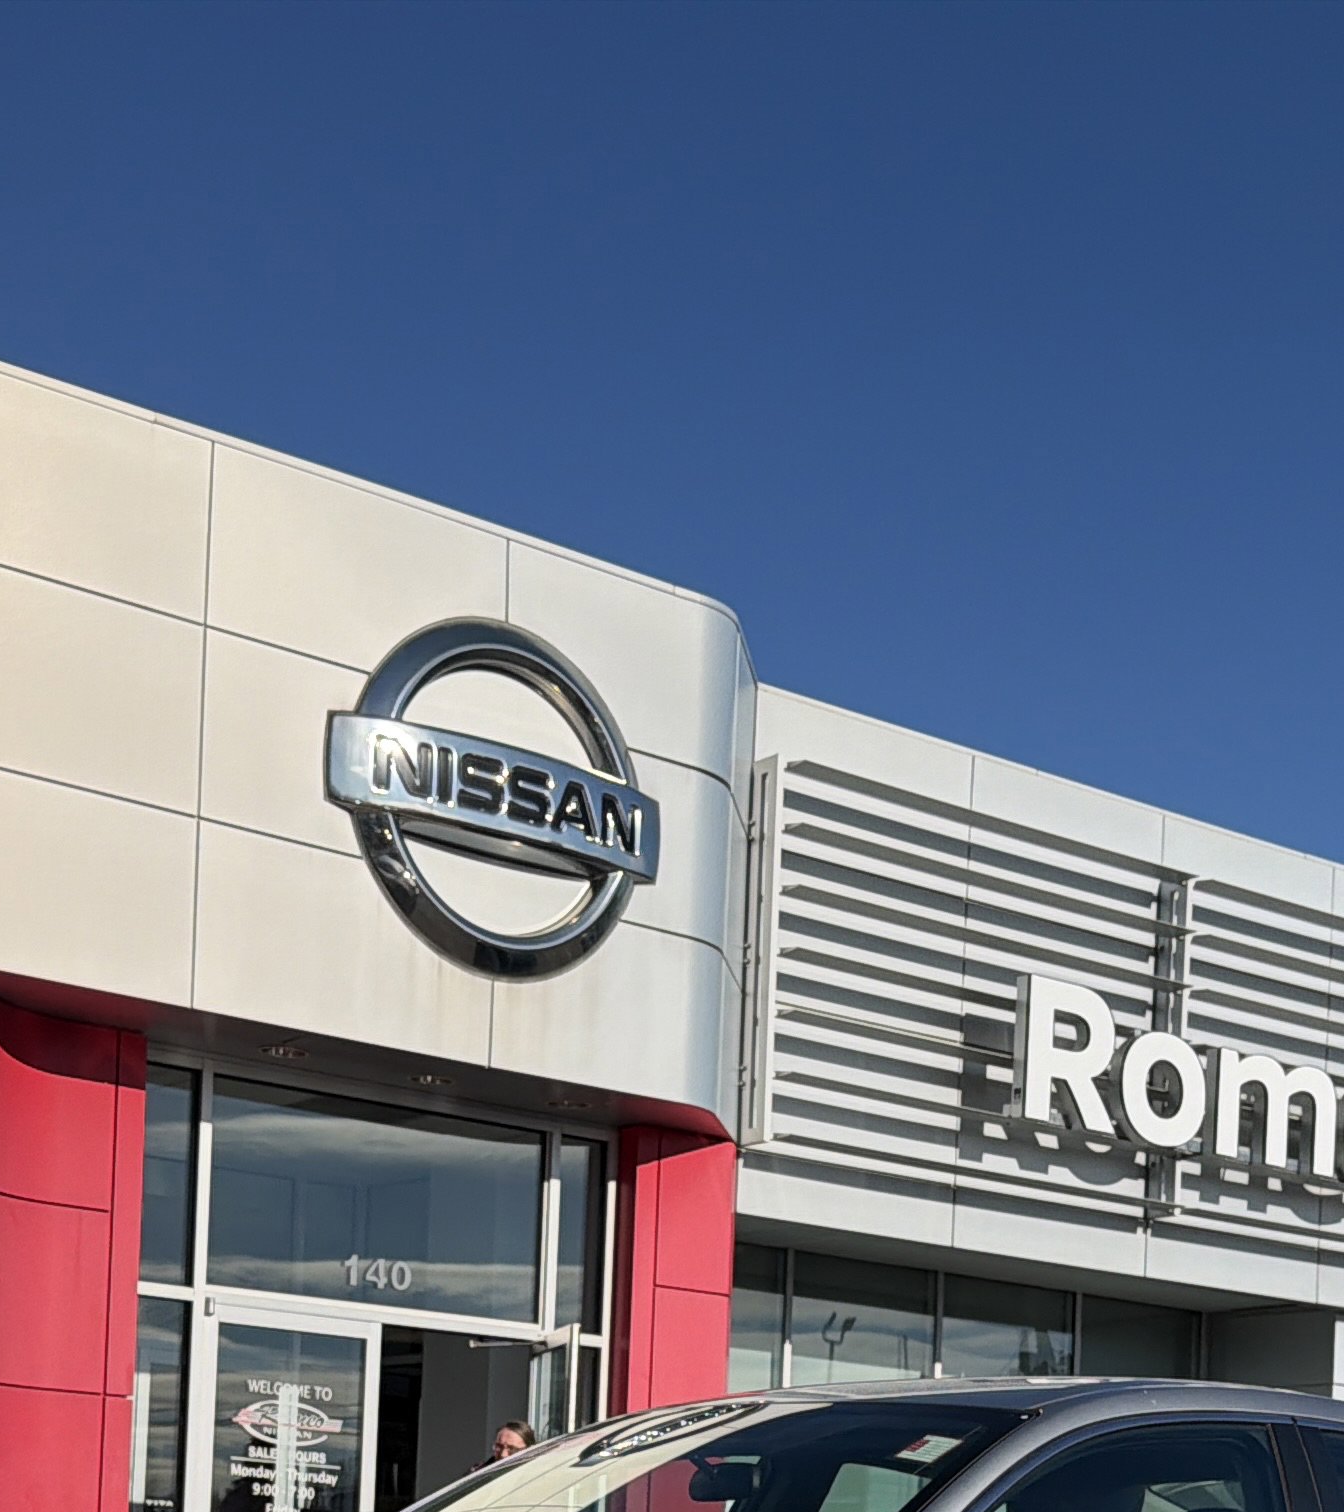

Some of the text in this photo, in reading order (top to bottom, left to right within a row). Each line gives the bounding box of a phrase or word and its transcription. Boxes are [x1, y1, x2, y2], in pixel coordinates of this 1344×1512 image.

[369, 731, 643, 857] NISSAN
[344, 1254, 412, 1291] 140
[314, 1386, 333, 1401] TO
[263, 1426, 312, 1440] NIAN
[248, 1445, 282, 1459] SALE
[231, 1463, 276, 1481] Monday
[287, 1468, 338, 1487] Thursday
[252, 1482, 279, 1497] 9:00
